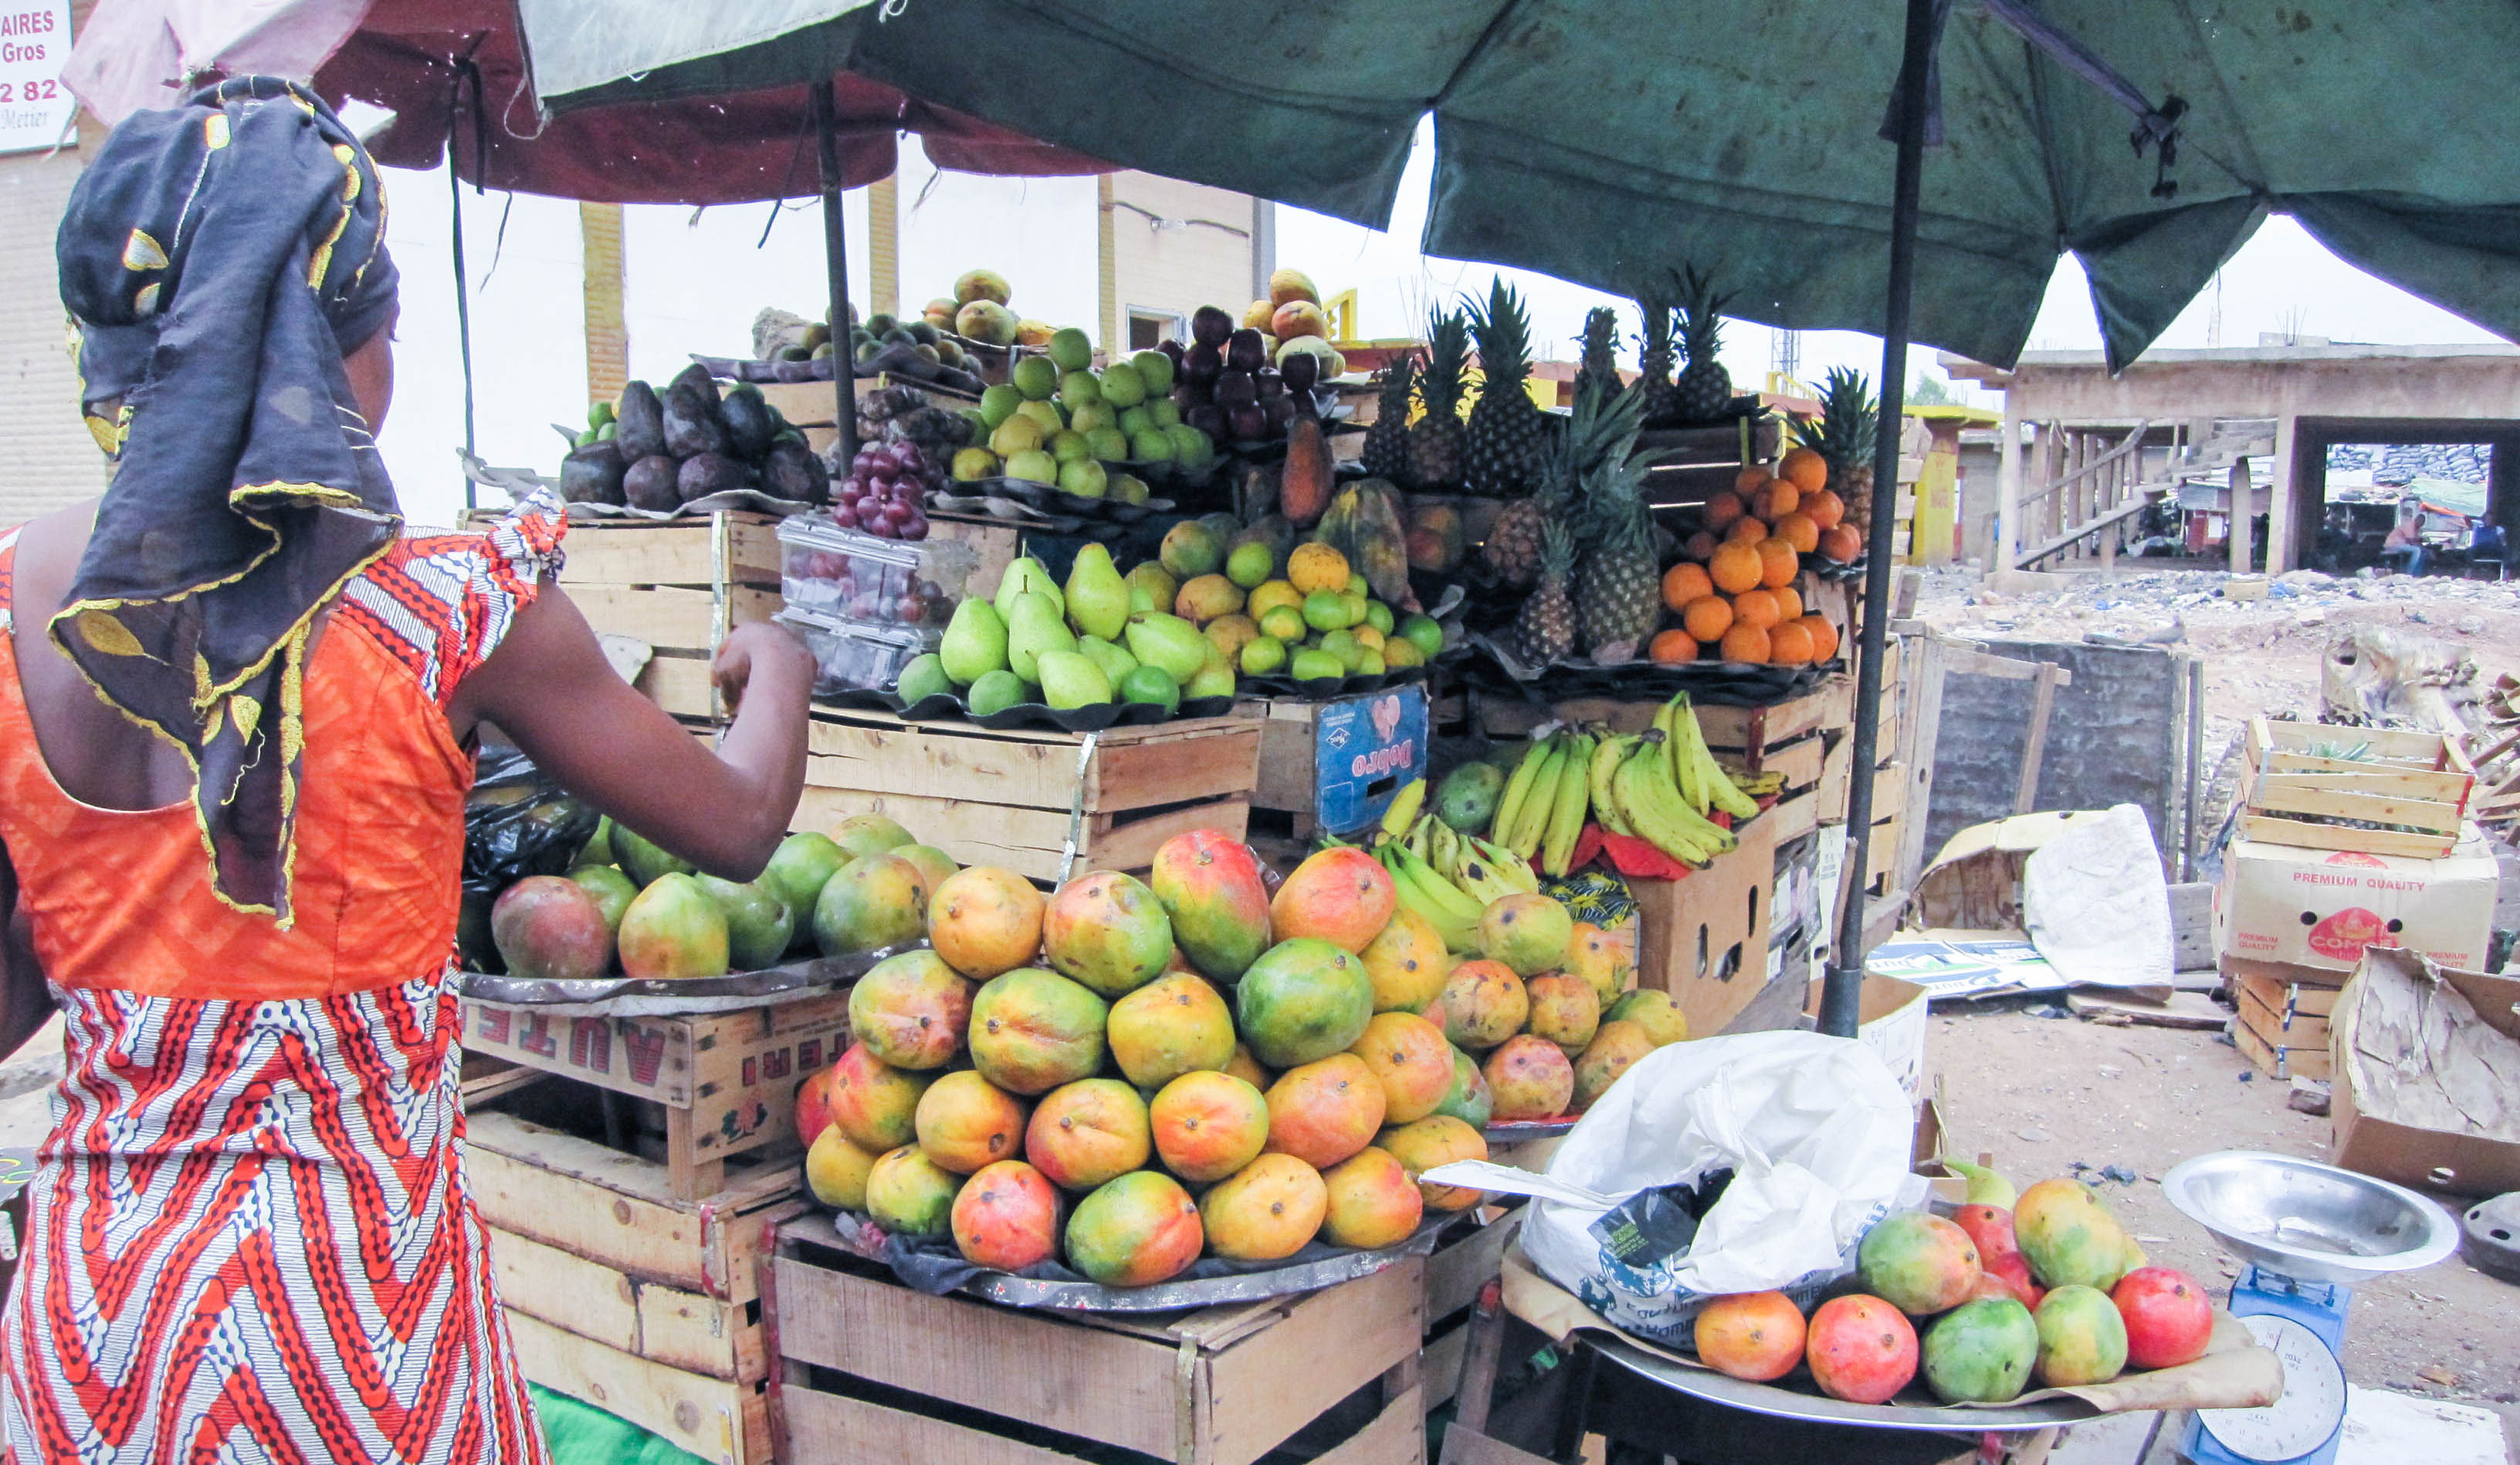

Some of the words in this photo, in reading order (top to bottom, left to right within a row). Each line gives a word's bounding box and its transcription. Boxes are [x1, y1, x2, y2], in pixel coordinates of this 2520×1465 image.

[2, 11, 54, 36] AIRES
[3, 42, 46, 63] Gros
[24, 80, 57, 101] 82
[1352, 739, 1412, 777] Dobro
[2293, 872, 2358, 887] PREMIUM
[2366, 878, 2425, 892] QUALITY
[2238, 932, 2278, 942] PREMIUM
[2238, 941, 2277, 951] QUALITY
[2427, 951, 2468, 960] PREMIUM
[461, 1005, 666, 1087] AUTE
[741, 1032, 847, 1087] TERI
